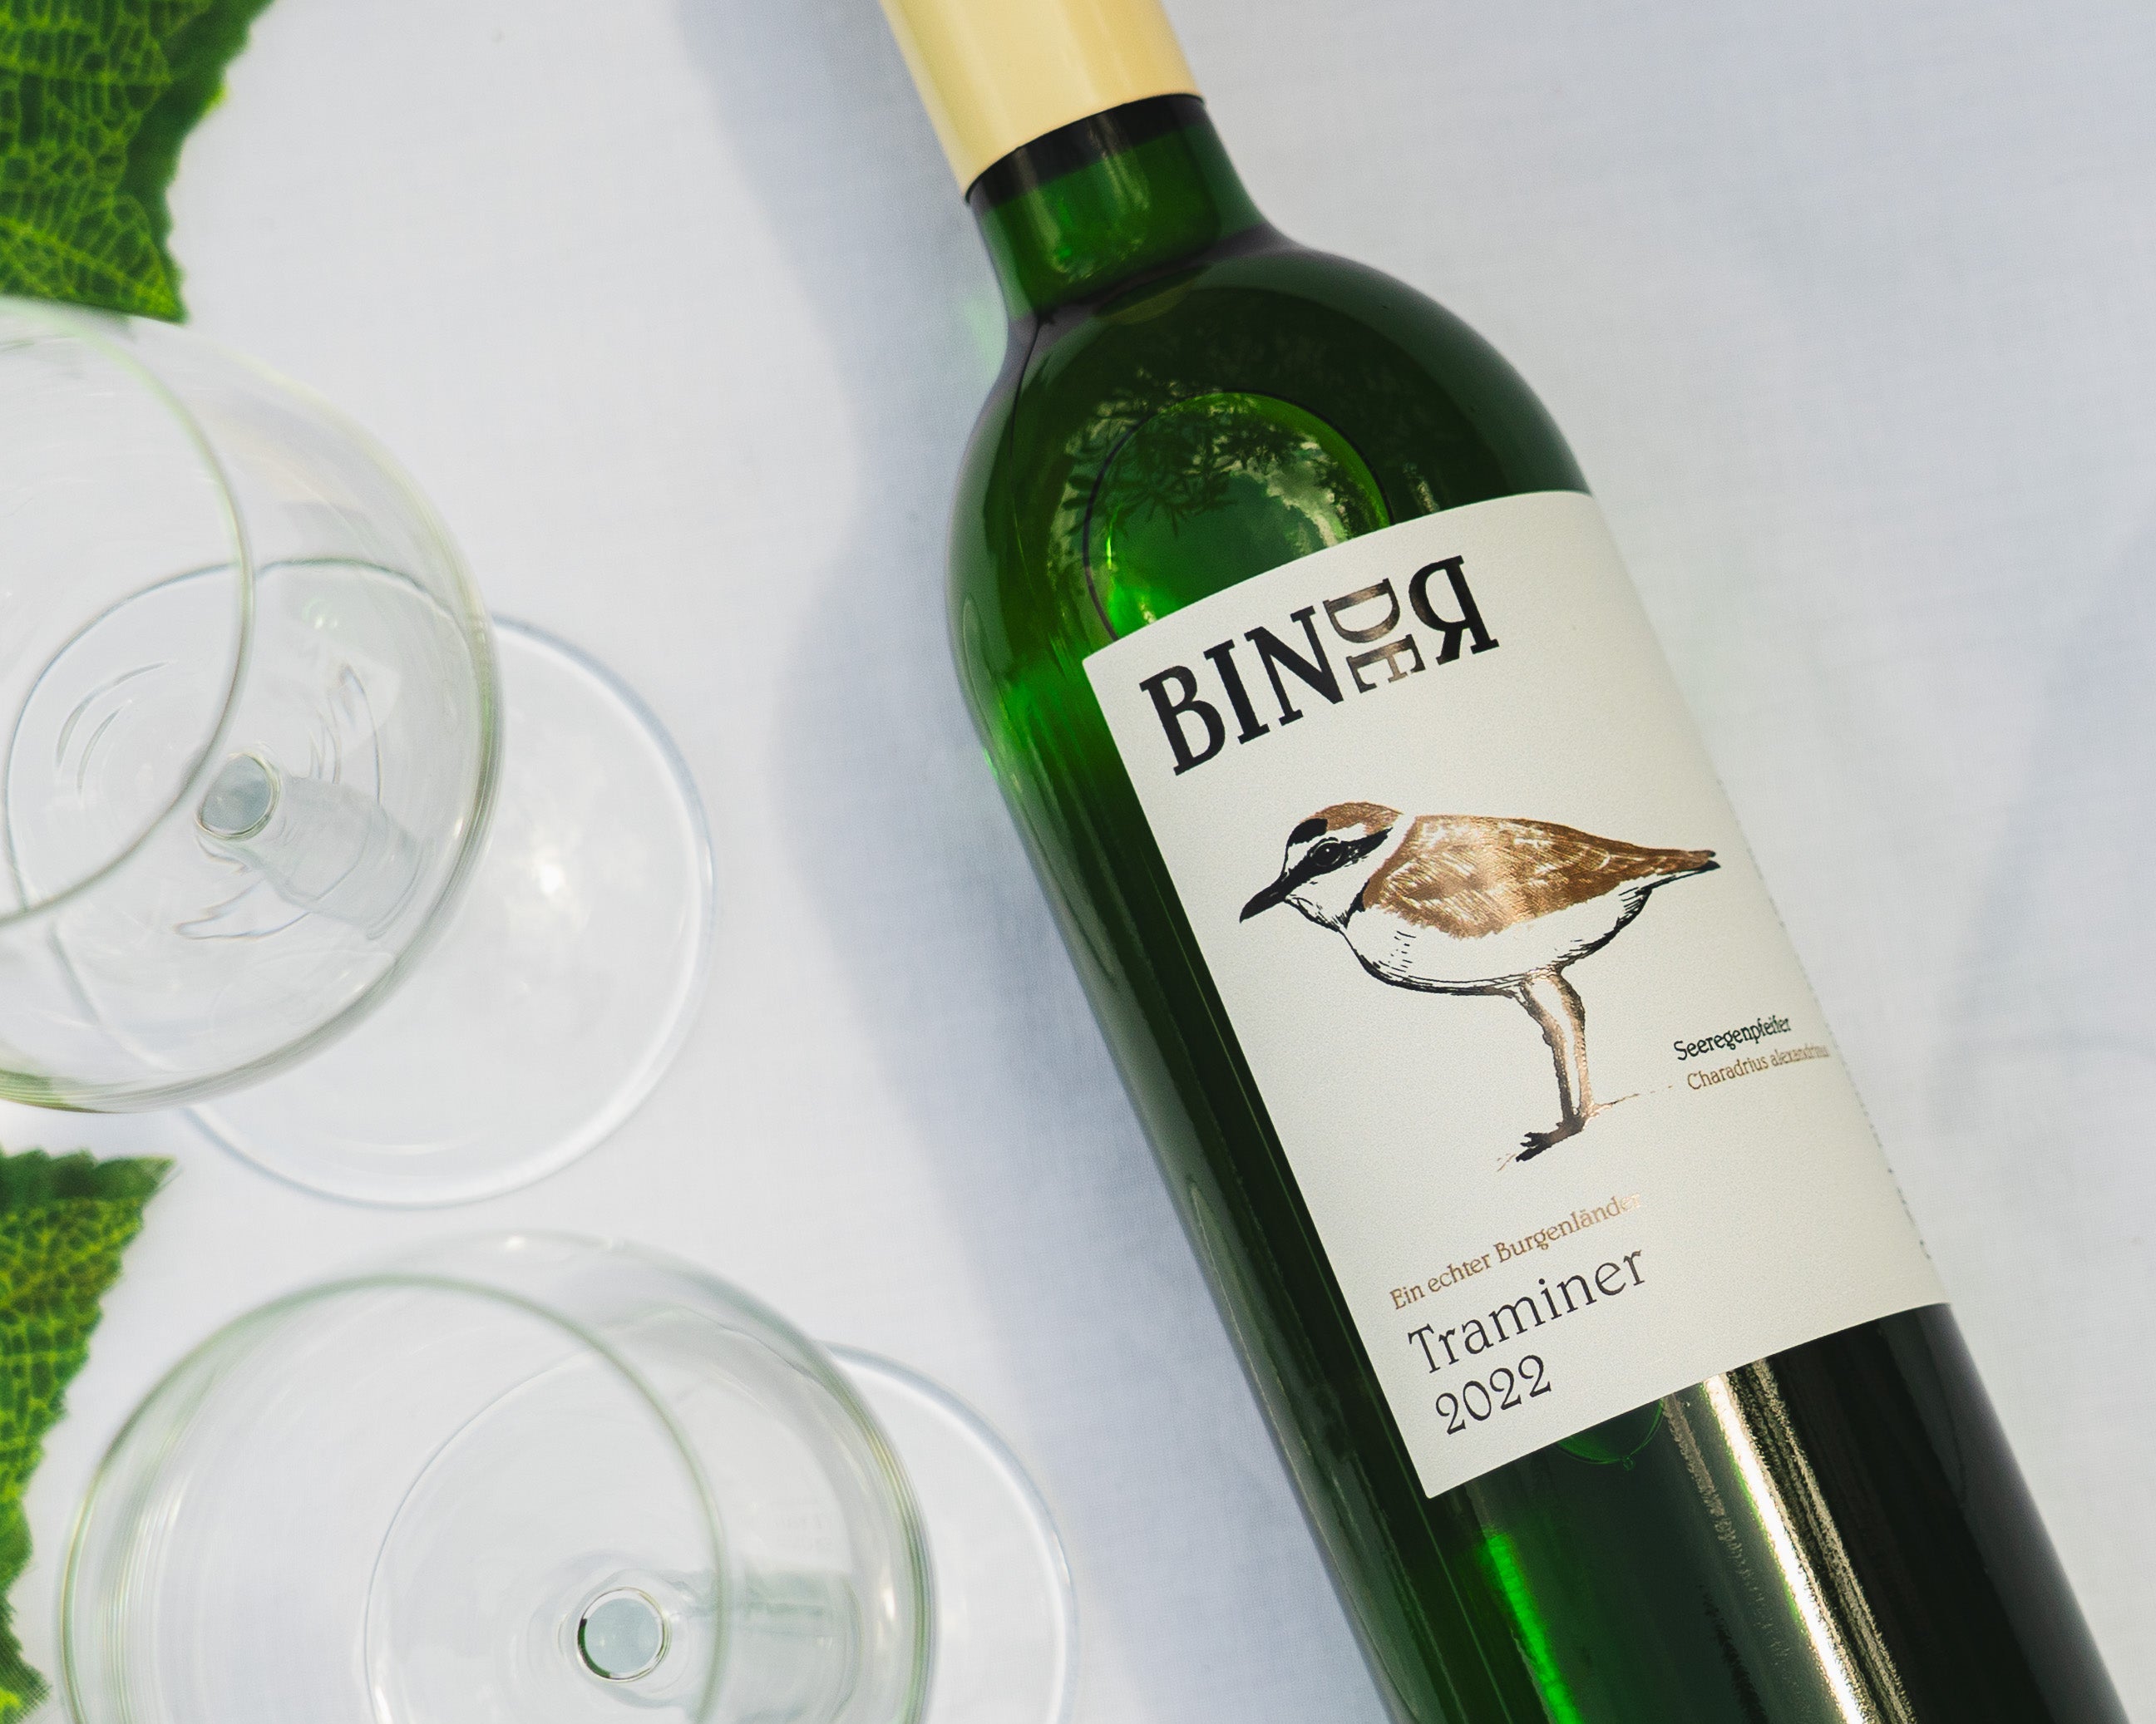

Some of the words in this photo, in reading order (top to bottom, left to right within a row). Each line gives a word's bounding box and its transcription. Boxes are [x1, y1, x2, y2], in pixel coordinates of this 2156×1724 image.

[1674, 1015, 1791, 1061] Seeregenpfeifer
[1687, 1057, 1769, 1090] Charadrius
[1389, 1286, 1425, 1310] Ein
[1427, 1254, 1492, 1293] echter
[1493, 1193, 1641, 1263] Burgenländer
[1408, 1249, 1645, 1374] Traminer
[1435, 1355, 1552, 1436] 2022
